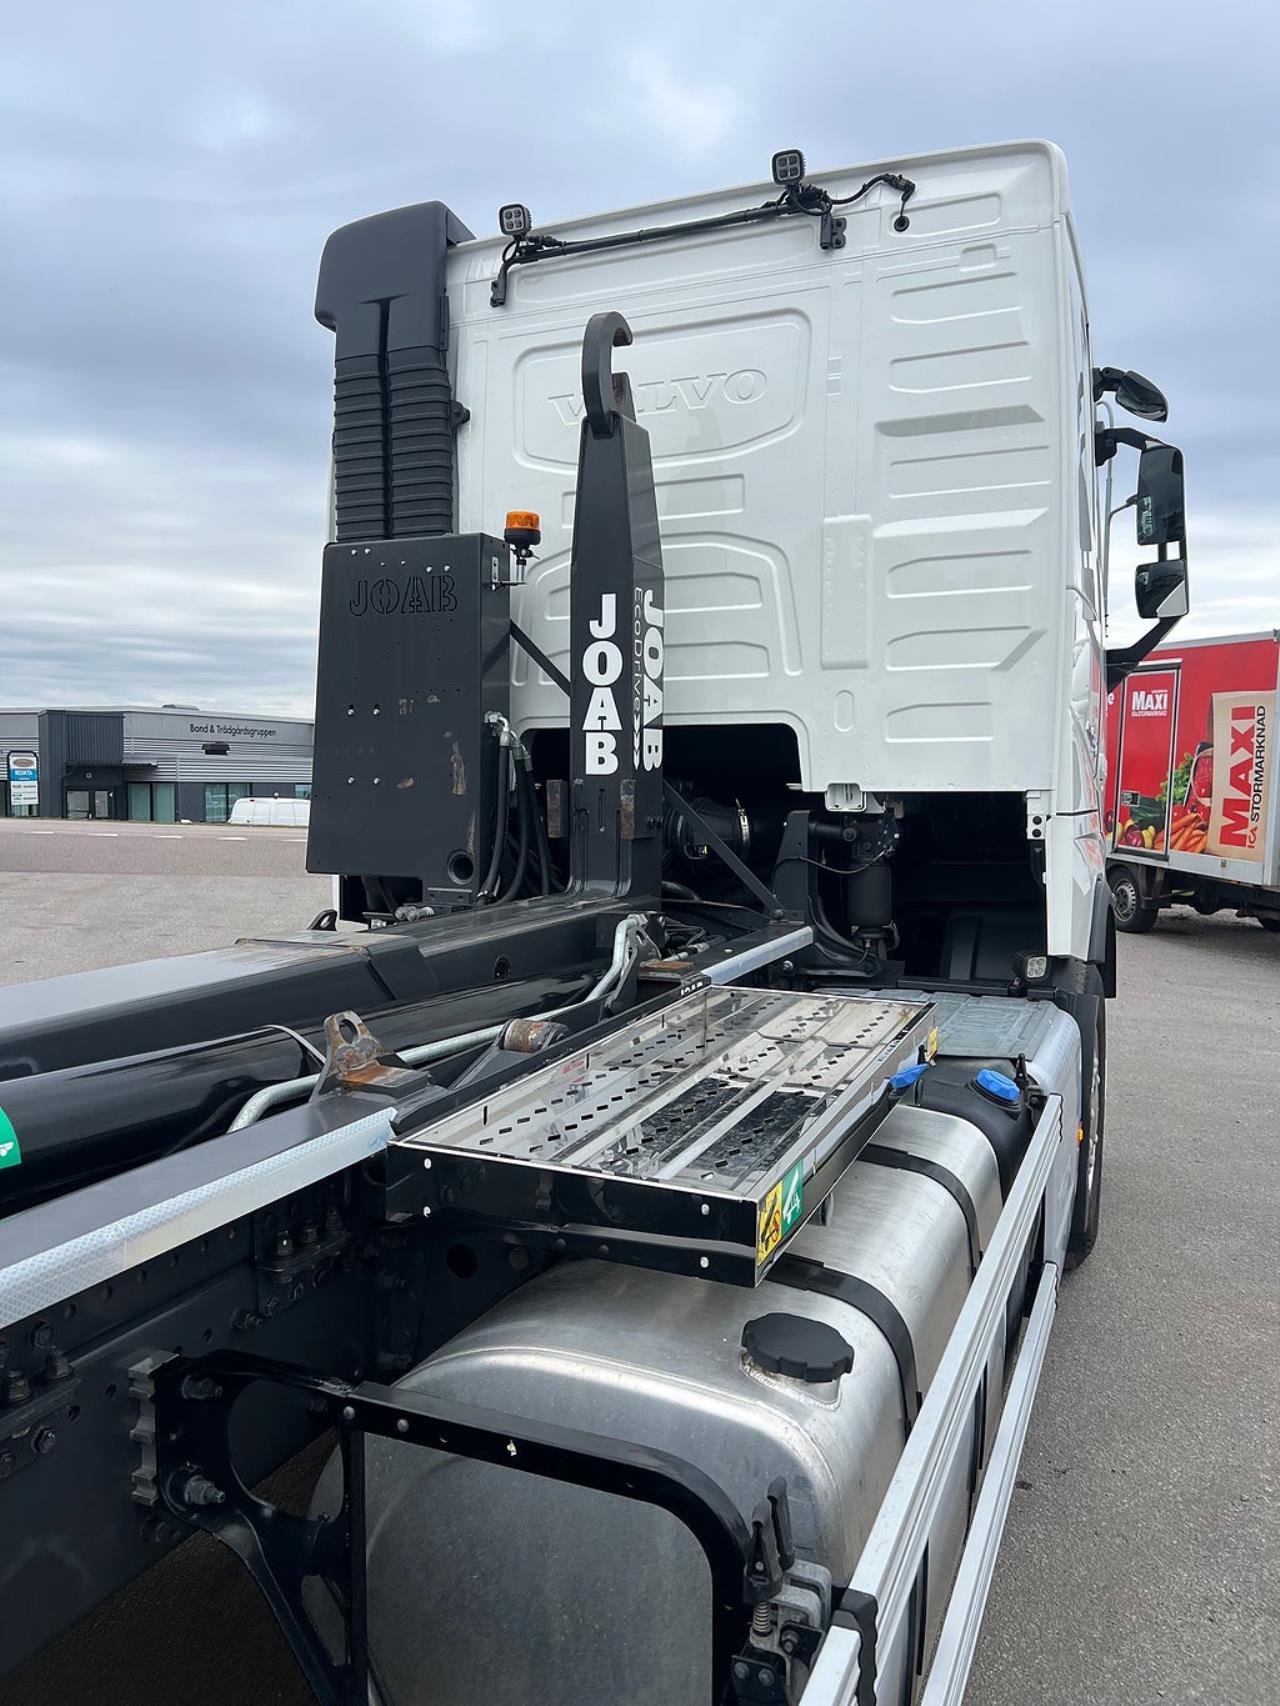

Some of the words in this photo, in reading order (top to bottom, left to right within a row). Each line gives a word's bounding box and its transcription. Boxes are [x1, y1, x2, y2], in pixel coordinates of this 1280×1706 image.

[548, 368, 768, 426] VLVO
[349, 574, 458, 617] JOAB
[582, 593, 623, 775] JOAB
[643, 589, 664, 771] JOAB
[1219, 705, 1256, 848] MAXI
[1250, 705, 1266, 823] STORMARKNAD
